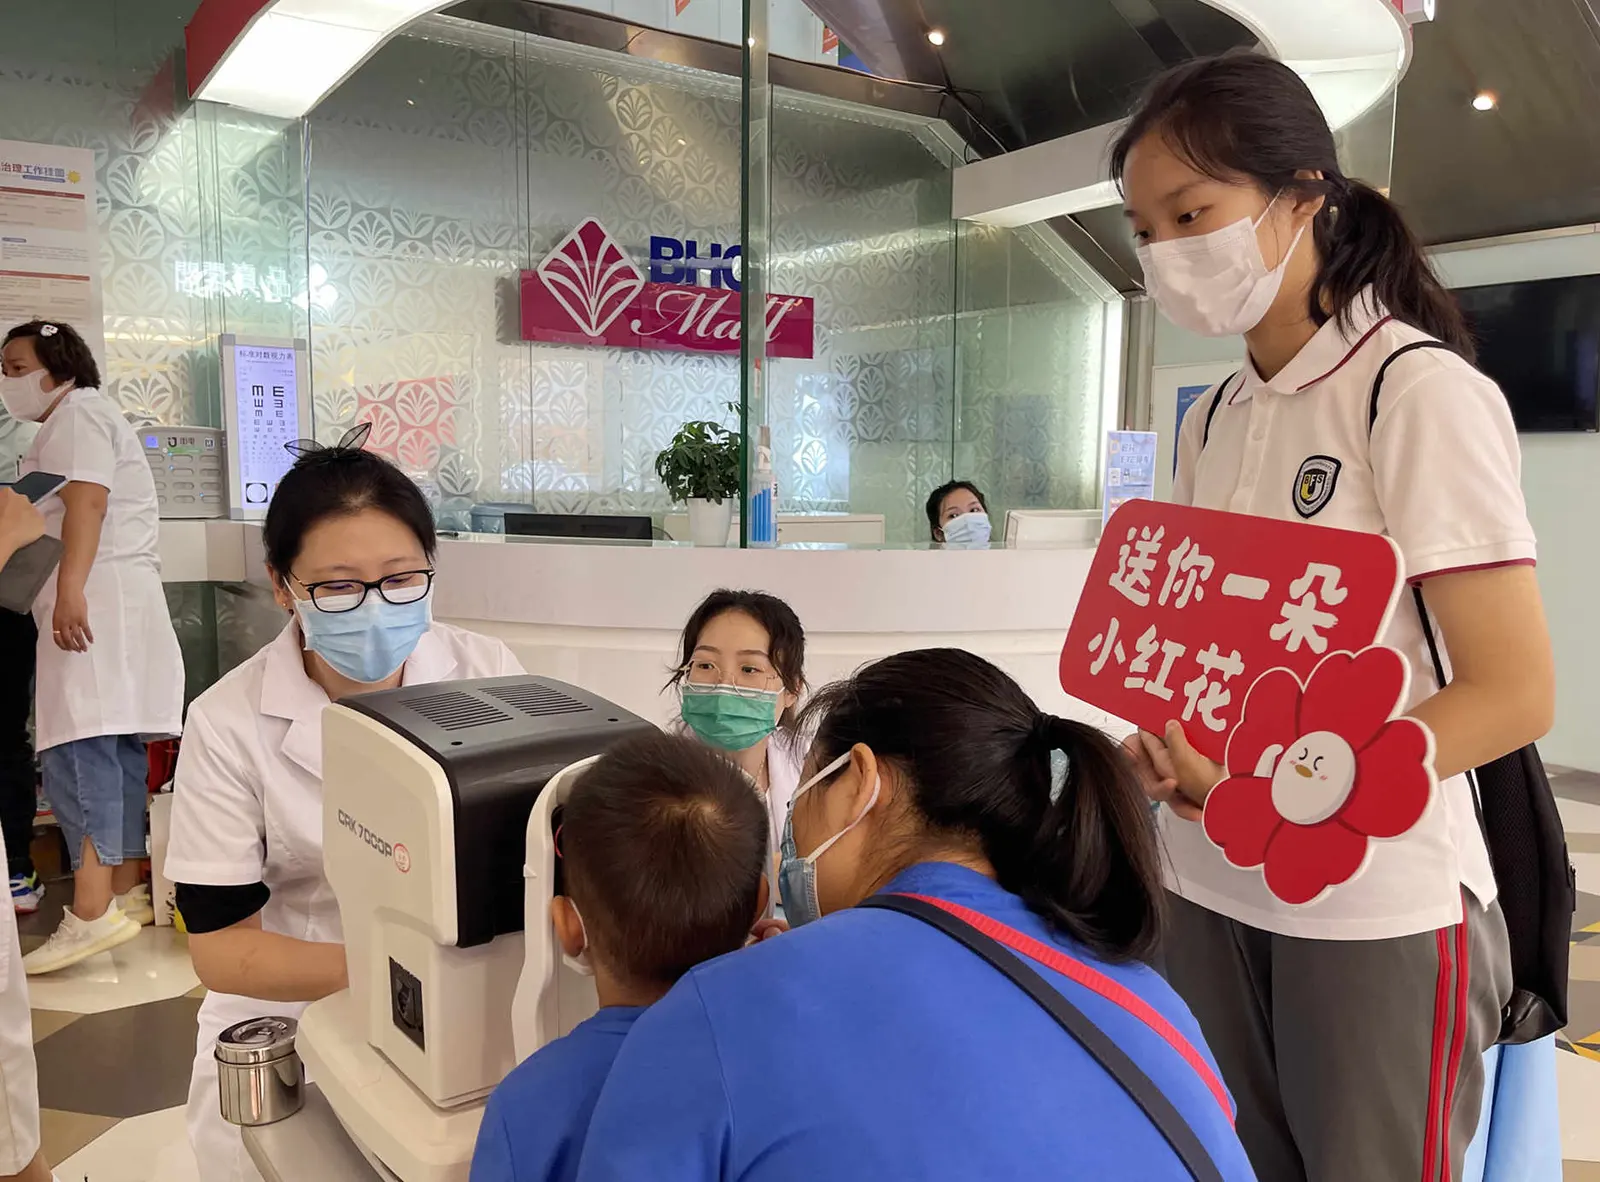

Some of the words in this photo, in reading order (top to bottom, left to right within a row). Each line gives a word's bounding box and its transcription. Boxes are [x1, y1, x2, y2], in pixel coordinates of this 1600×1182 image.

[1304, 474, 1325, 486] BFS
[1108, 525, 1348, 654] 送你一朵
[1088, 617, 1245, 732] 小红花
[338, 808, 357, 836] CRK
